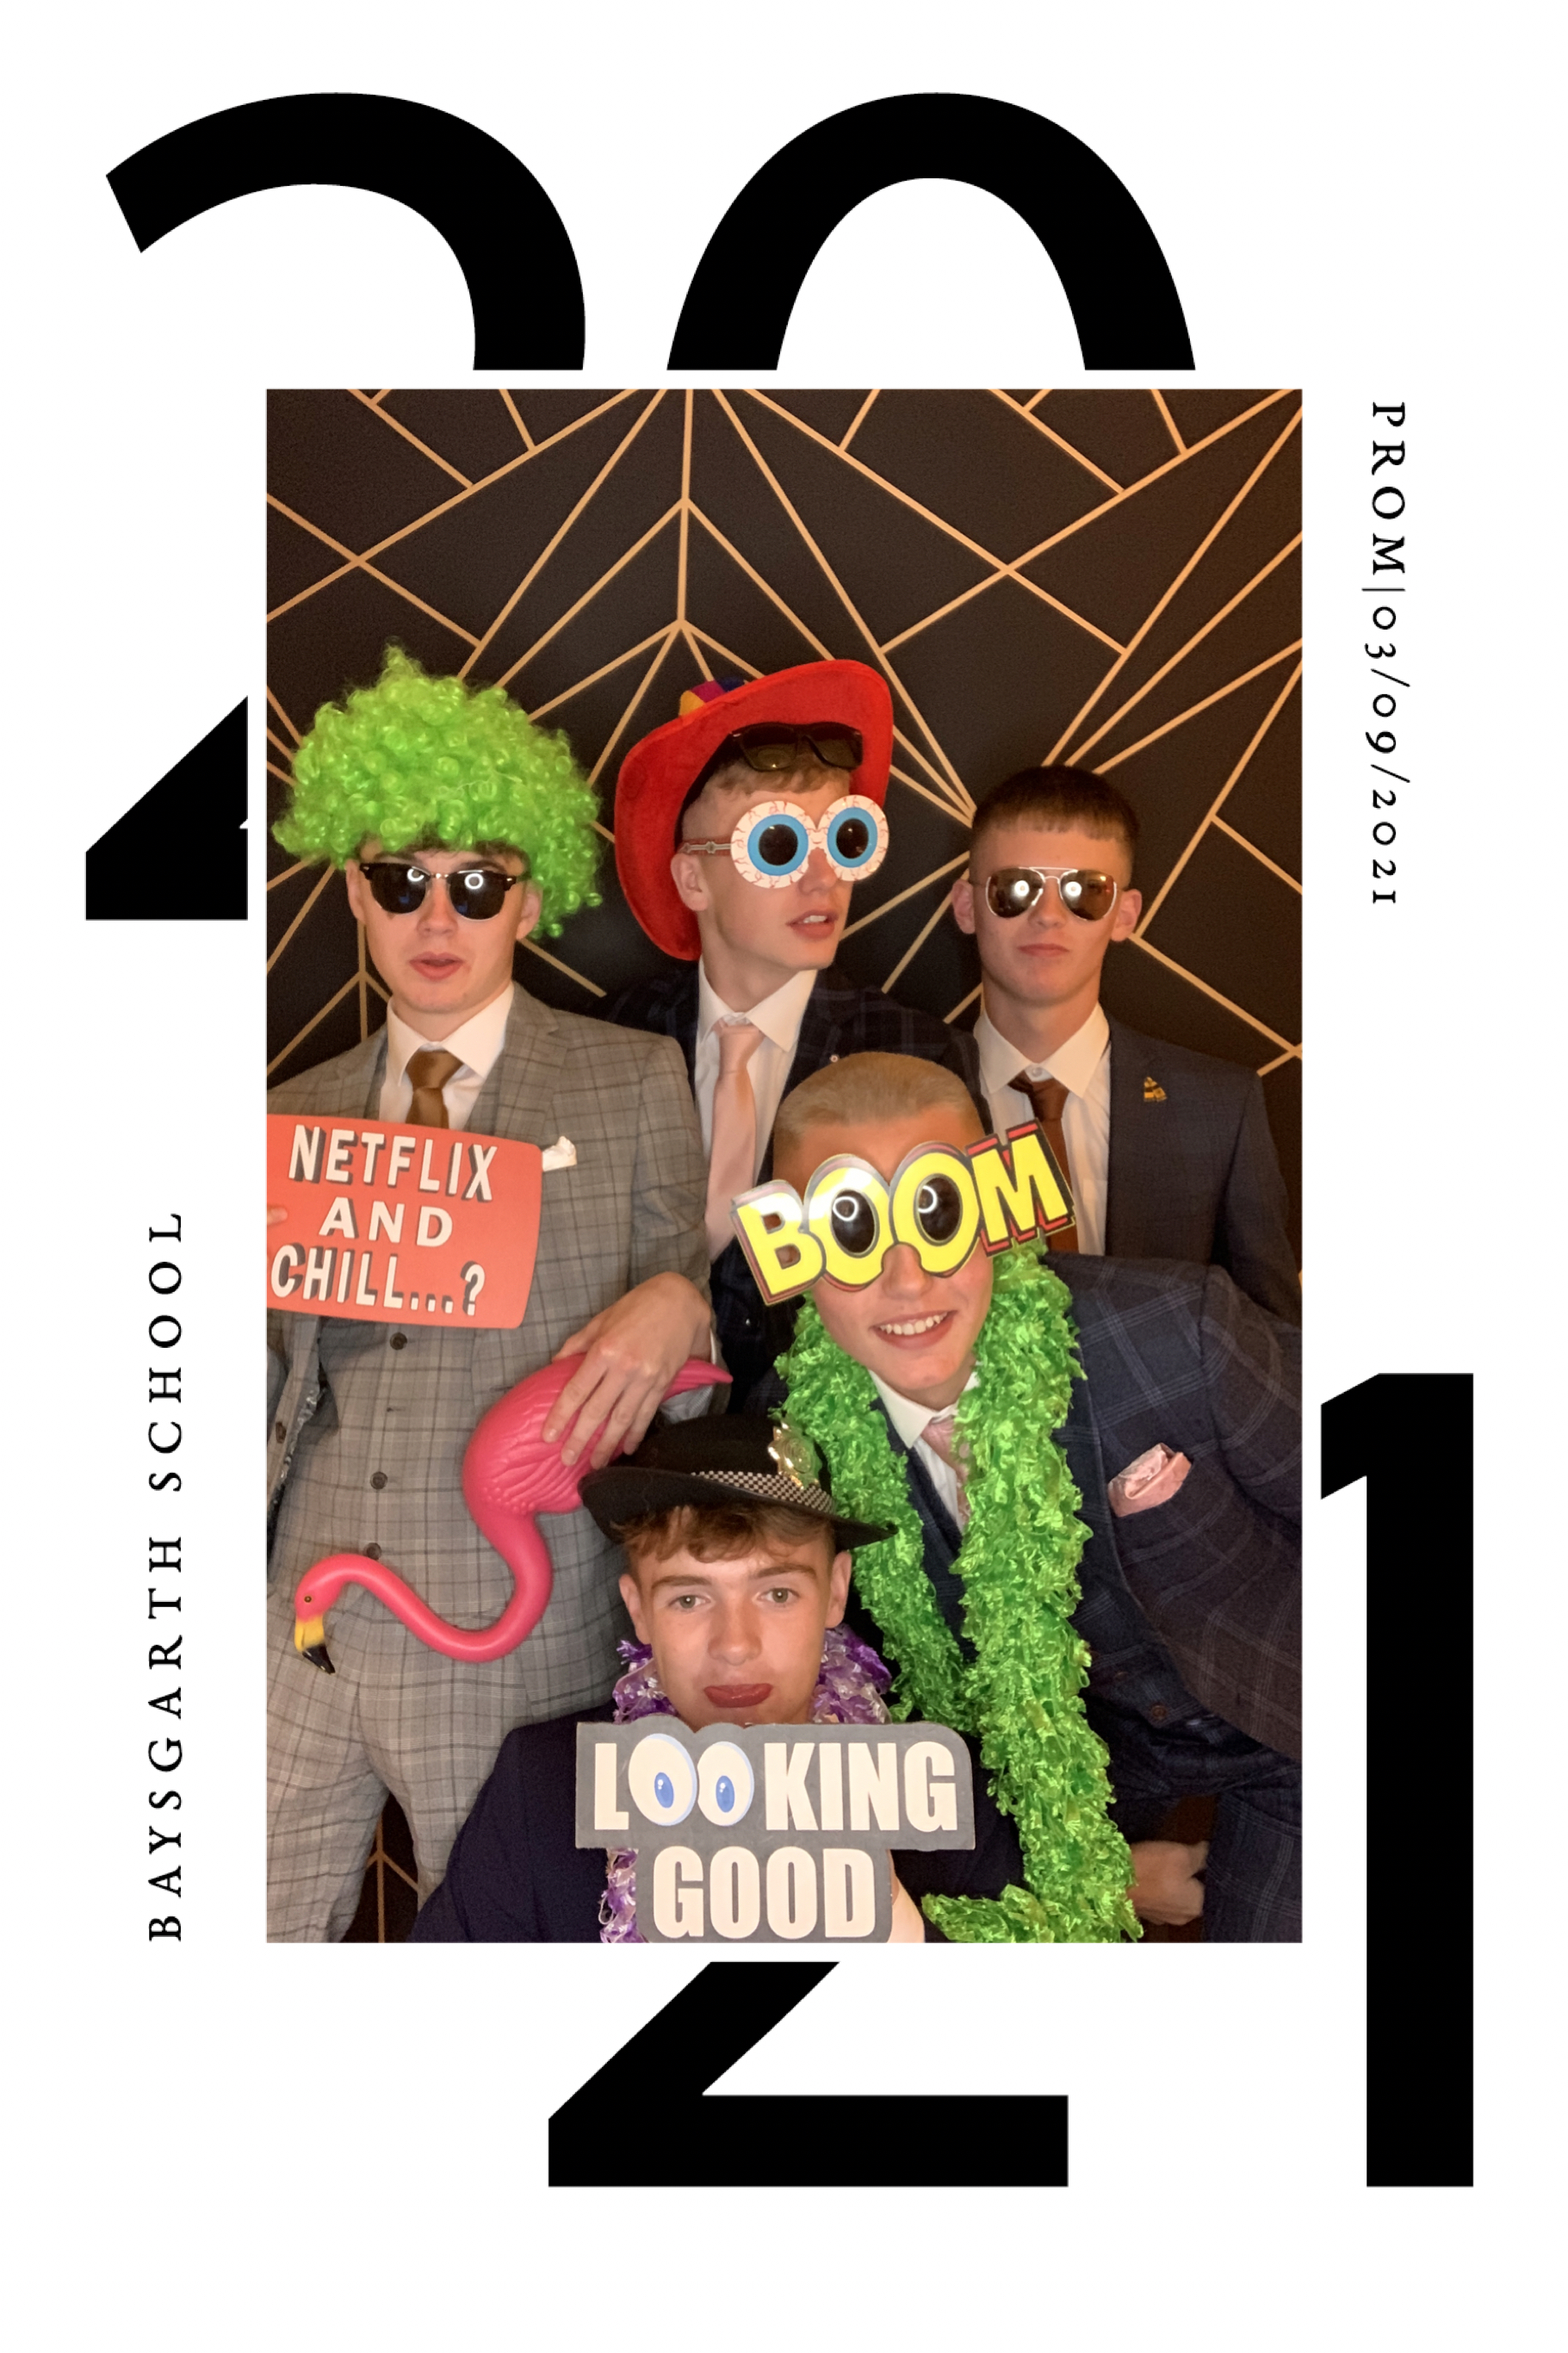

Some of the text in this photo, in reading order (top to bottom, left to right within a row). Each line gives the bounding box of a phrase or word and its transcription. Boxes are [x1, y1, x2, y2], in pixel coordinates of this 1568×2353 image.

[288, 1123, 498, 1202] NETFLIX
[318, 1196, 453, 1247] AND
[732, 1121, 1075, 1305] BOOM
[270, 1243, 486, 1316] CHILL...?
[594, 1733, 958, 1832] LOOKING
[653, 1846, 876, 1940] GOOD
